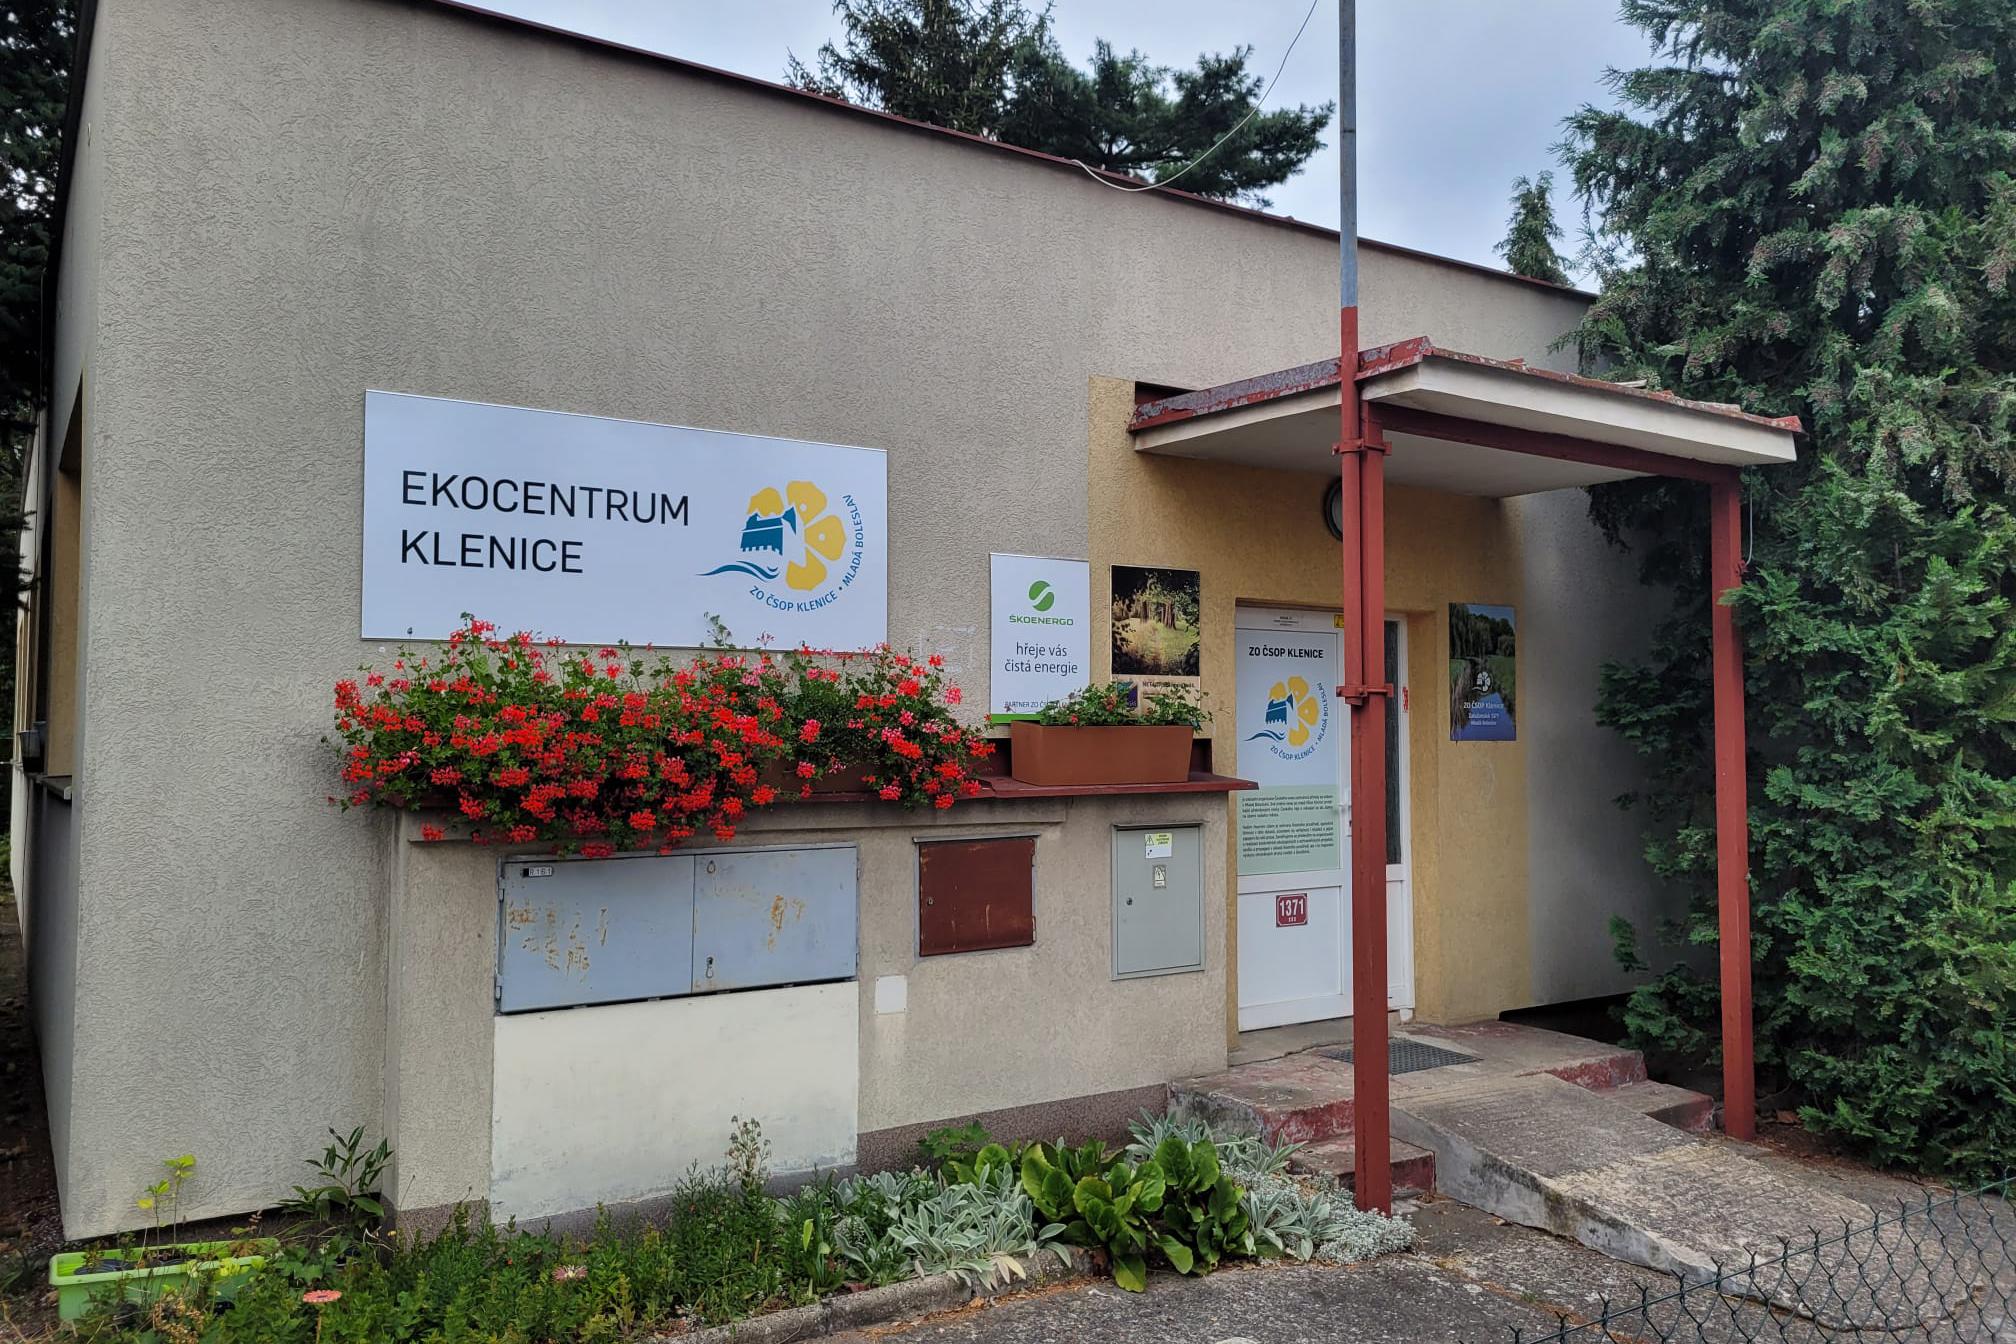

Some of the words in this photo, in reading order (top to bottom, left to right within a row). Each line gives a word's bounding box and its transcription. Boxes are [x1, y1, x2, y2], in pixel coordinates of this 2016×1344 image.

[402, 470, 689, 526] EKOCENTRUM
[842, 494, 864, 548] BOLESLAV
[401, 529, 584, 574] KLENICE
[842, 551, 863, 587] MLADÁ
[749, 585, 765, 601] ZO
[766, 593, 794, 612] ČSOP
[796, 590, 838, 612] KLENICE
[1016, 641, 1046, 659] hřeje
[1048, 644, 1067, 657] vás
[1249, 646, 1261, 657] ZO
[1262, 644, 1286, 658] ČSOP
[1287, 647, 1324, 659] KLENICE
[1004, 658, 1031, 673] čistá
[1035, 660, 1078, 677] energie
[1270, 744, 1279, 755] ZO
[1278, 749, 1294, 761] ČSOP
[1294, 747, 1315, 761] KLENICE
[1317, 717, 1329, 743] MLADÁ
[1280, 899, 1304, 916] 1371
